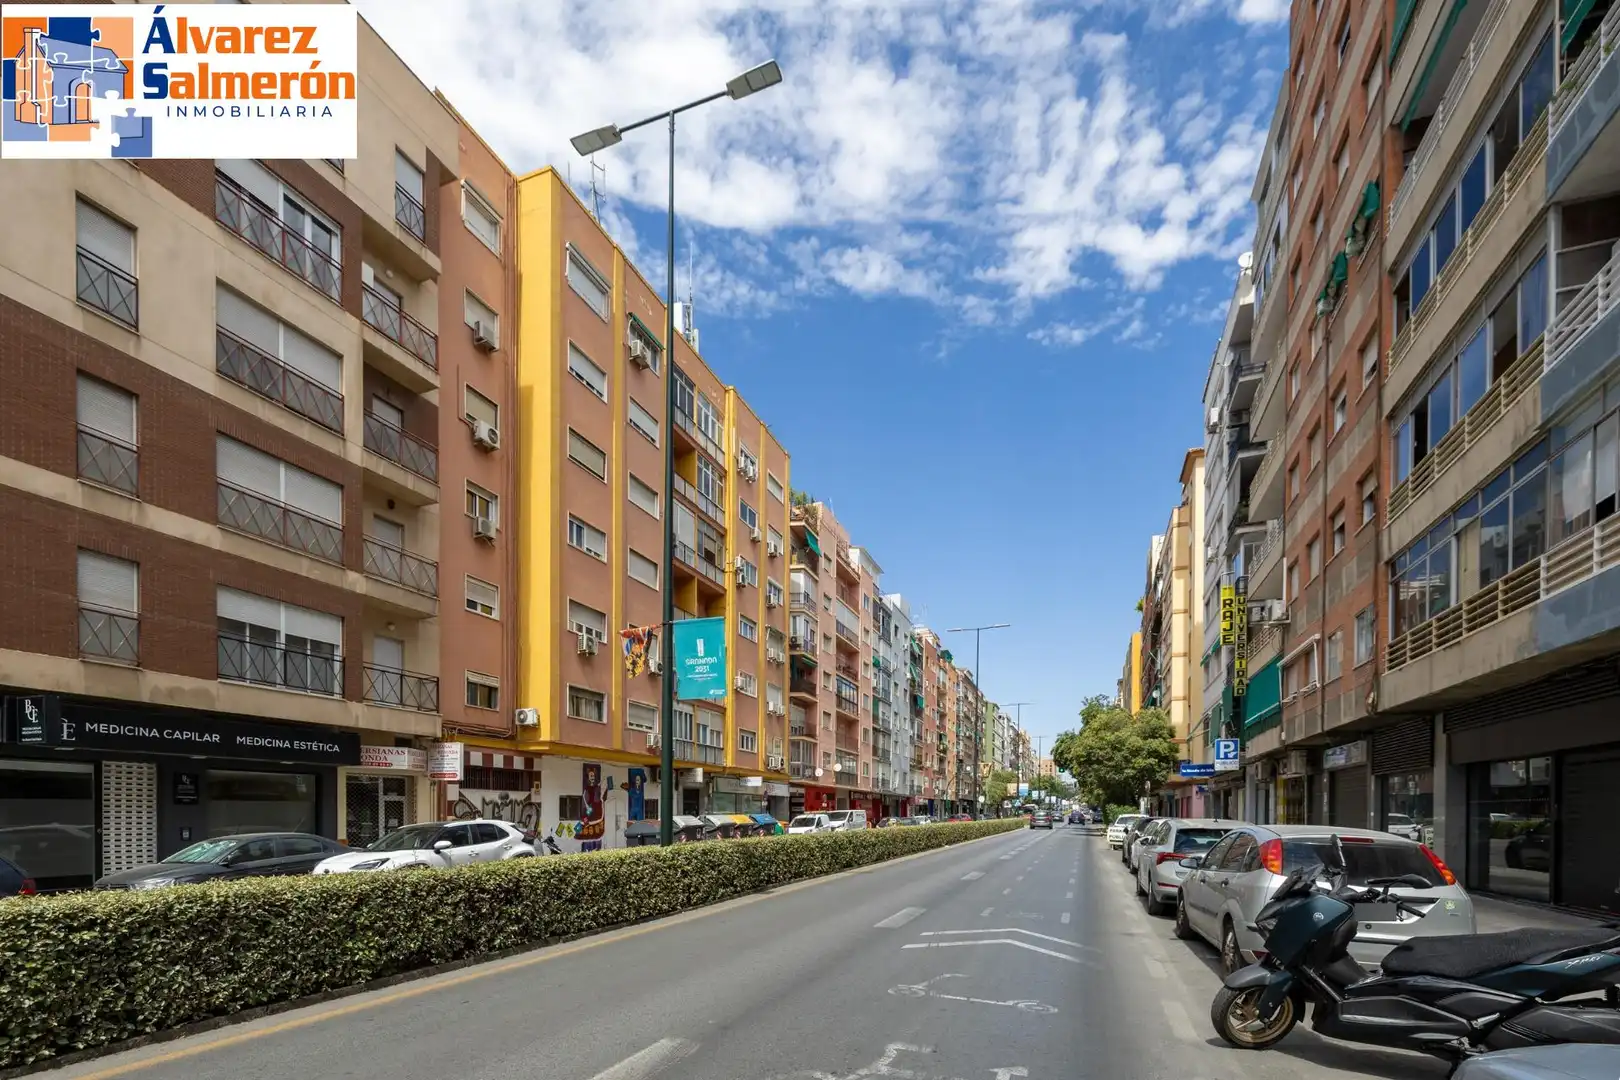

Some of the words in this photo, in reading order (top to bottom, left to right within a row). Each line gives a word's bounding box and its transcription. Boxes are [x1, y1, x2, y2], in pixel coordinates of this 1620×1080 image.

[1236, 596, 1246, 696] UNIVERSIDAD
[85, 722, 160, 738] MEDICINA
[163, 729, 220, 743] CAPILAR
[236, 736, 291, 749] MEDICINA
[293, 740, 340, 753] ESTÉTICA
